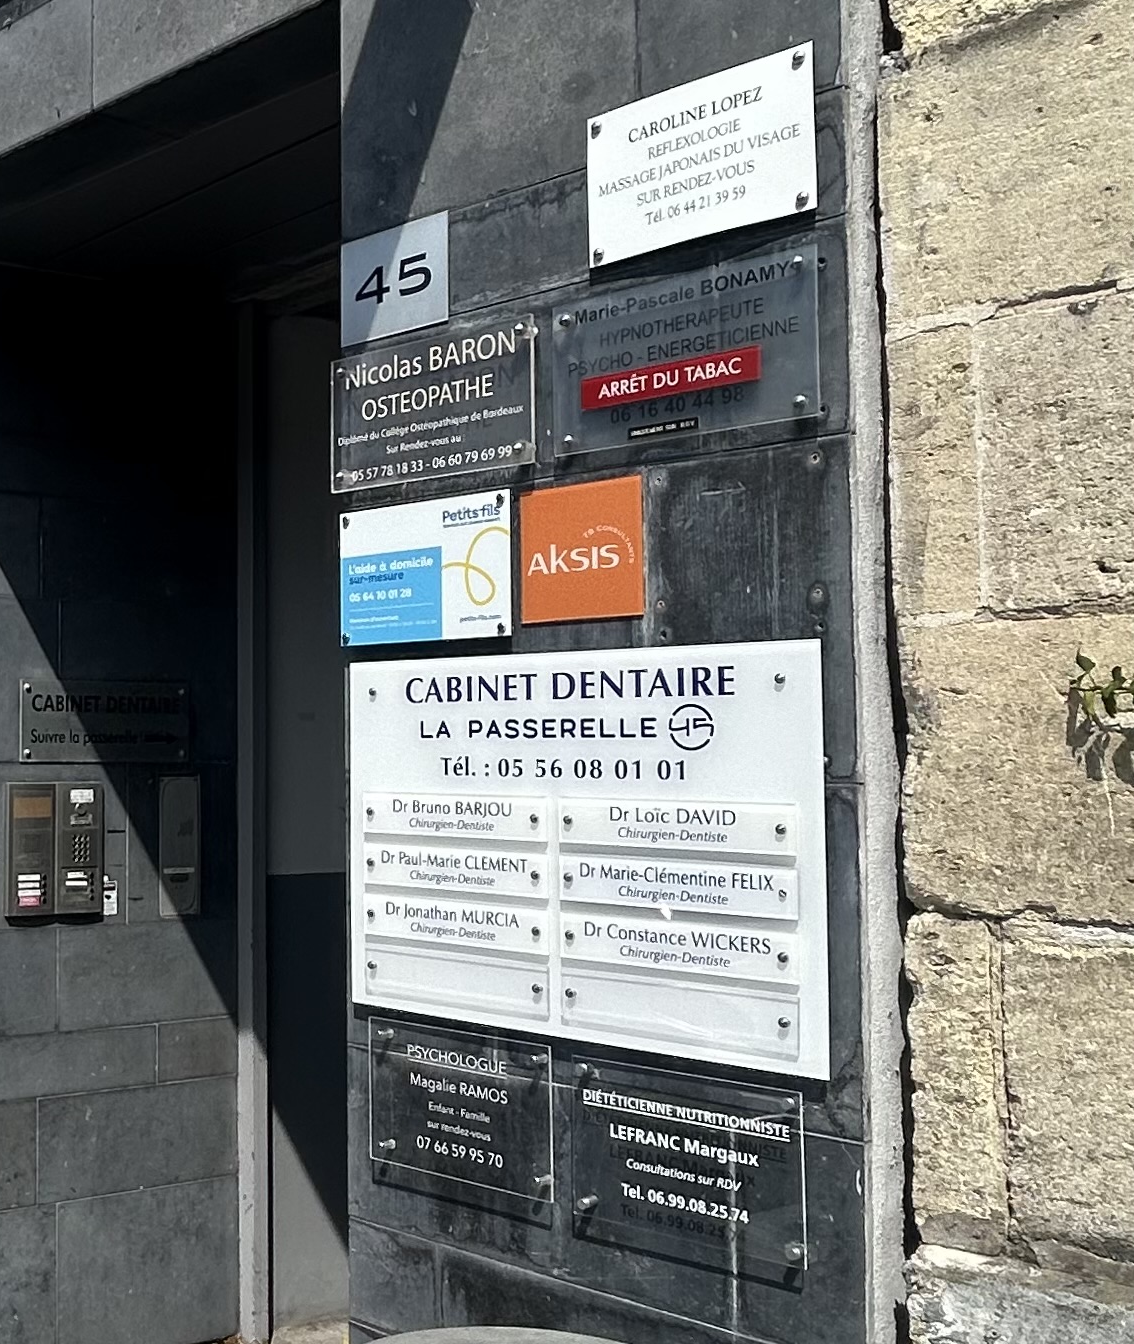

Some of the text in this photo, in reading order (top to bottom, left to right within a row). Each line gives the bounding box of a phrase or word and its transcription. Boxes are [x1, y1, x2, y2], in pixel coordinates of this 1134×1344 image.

[628, 86, 763, 143] CAROLINE LOPEZ
[647, 118, 741, 160] REFLEXOLOGIE
[598, 123, 801, 198] MASSAGE JAPONAIS DU VISAGE
[636, 159, 756, 207] SUR RENDEZ-VOUS
[645, 185, 746, 226] Tél. 06 44 21 39 59
[355, 252, 432, 304] 45
[574, 260, 790, 326] Marie-Pascale BONAMY
[599, 297, 764, 348] HYPNOTHERAPEUTE
[345, 328, 516, 391] Nicolas BARON
[568, 316, 800, 378] PSYCHO ENERGETICIENNE
[598, 357, 742, 400] ARRÊT DU TABAC
[361, 373, 494, 421] OSTEOPATHE
[610, 386, 745, 424] 06 16 40 44 98
[370, 430, 380, 441] du
[470, 411, 481, 422] de
[483, 405, 524, 419] Bordeaux
[386, 435, 462, 455] Sur Rendez-vous au
[351, 445, 513, 482] 05 57 78 18 33 06 60 79 69 99
[390, 556, 434, 571] domicile
[348, 592, 361, 603] 05
[363, 590, 375, 602] 64
[376, 589, 387, 600] 10
[387, 588, 399, 600] 01
[405, 665, 736, 704] CABINET DENTAIRE
[31, 694, 180, 715] CABINET DENTAIRE
[30, 728, 139, 747] Suivre la passerelle
[420, 719, 451, 739] LA
[468, 717, 657, 739] PASSERELLE
[440, 756, 686, 781] Tél. 05 56 08 01 01
[392, 799, 512, 818] Dr Bruno BARJOU
[409, 817, 495, 832] Chirurgien-Dentiste
[609, 806, 736, 826] Dr Loïc DAVID
[618, 826, 728, 843] Chirurgien-Dentiste
[381, 850, 527, 873] Dr Paul-Marie CLEMENT
[579, 862, 774, 892] Dr Marie-Clémentine FELIX
[409, 870, 495, 887] Chirurgien-Dentiste
[618, 886, 729, 905] Chirurgien-Dentiste
[385, 901, 520, 929] Dr Jonathan MURCIA
[410, 922, 496, 941] Chirurgien-Dentiste
[584, 921, 771, 955] Dr Constance WICKERS
[619, 945, 730, 968] Chirurgien-Dentiste
[406, 1044, 508, 1075] PSYCHOLOGUE
[410, 1072, 508, 1105] Magalie RAMOS
[428, 1101, 491, 1124] Enfant Famille
[676, 1106, 790, 1138] NUTRITIONNISTE
[427, 1120, 491, 1142] sur rendez-vous
[609, 1123, 760, 1168] LEFRANC Margaux
[417, 1135, 504, 1168] 07 66 59 95 70
[626, 1158, 742, 1192] Consultations sur RDV
[621, 1182, 750, 1224] Tel. 06.99.08.25.74
